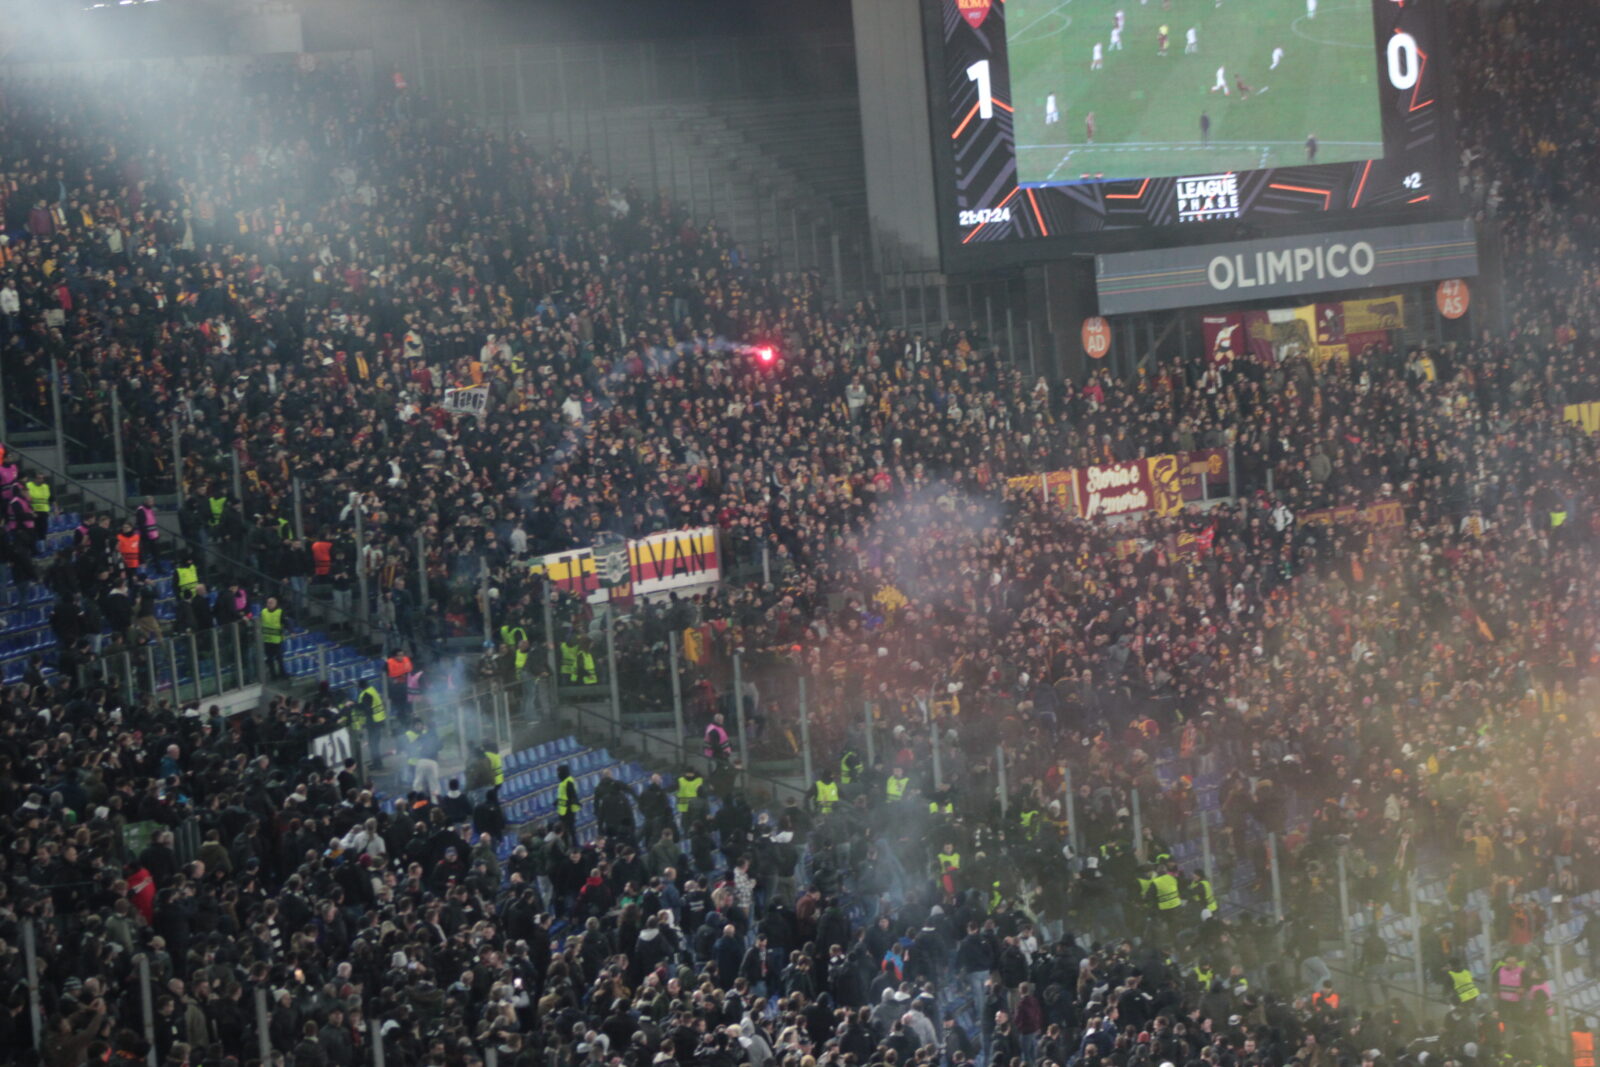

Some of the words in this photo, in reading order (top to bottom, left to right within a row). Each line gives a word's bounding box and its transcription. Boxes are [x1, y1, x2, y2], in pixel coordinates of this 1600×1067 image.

[1387, 33, 1418, 90] 0
[966, 59, 993, 119] 1
[1176, 178, 1238, 200] LEAGUE
[1403, 172, 1423, 189] +2
[1178, 195, 1239, 212] PHASE
[1208, 241, 1375, 290] OLIMPICO
[1443, 296, 1463, 314] AS
[1088, 335, 1106, 353] AD
[634, 532, 705, 585] IVAN
